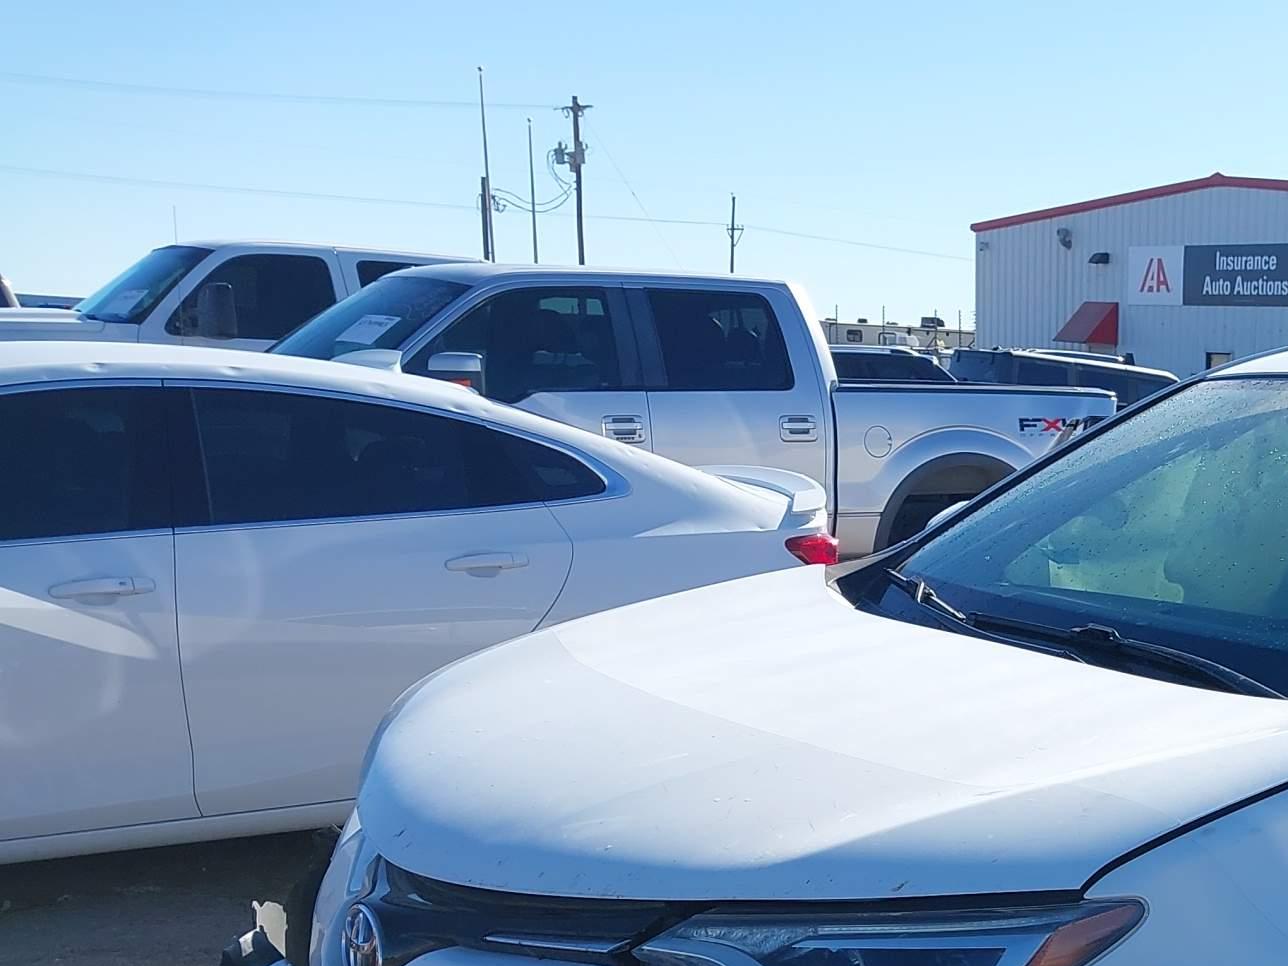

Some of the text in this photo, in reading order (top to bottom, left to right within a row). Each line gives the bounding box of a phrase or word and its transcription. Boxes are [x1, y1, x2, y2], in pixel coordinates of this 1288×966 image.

[1215, 251, 1277, 271] Insurance
[1202, 275, 1288, 296] Auto Auctions
